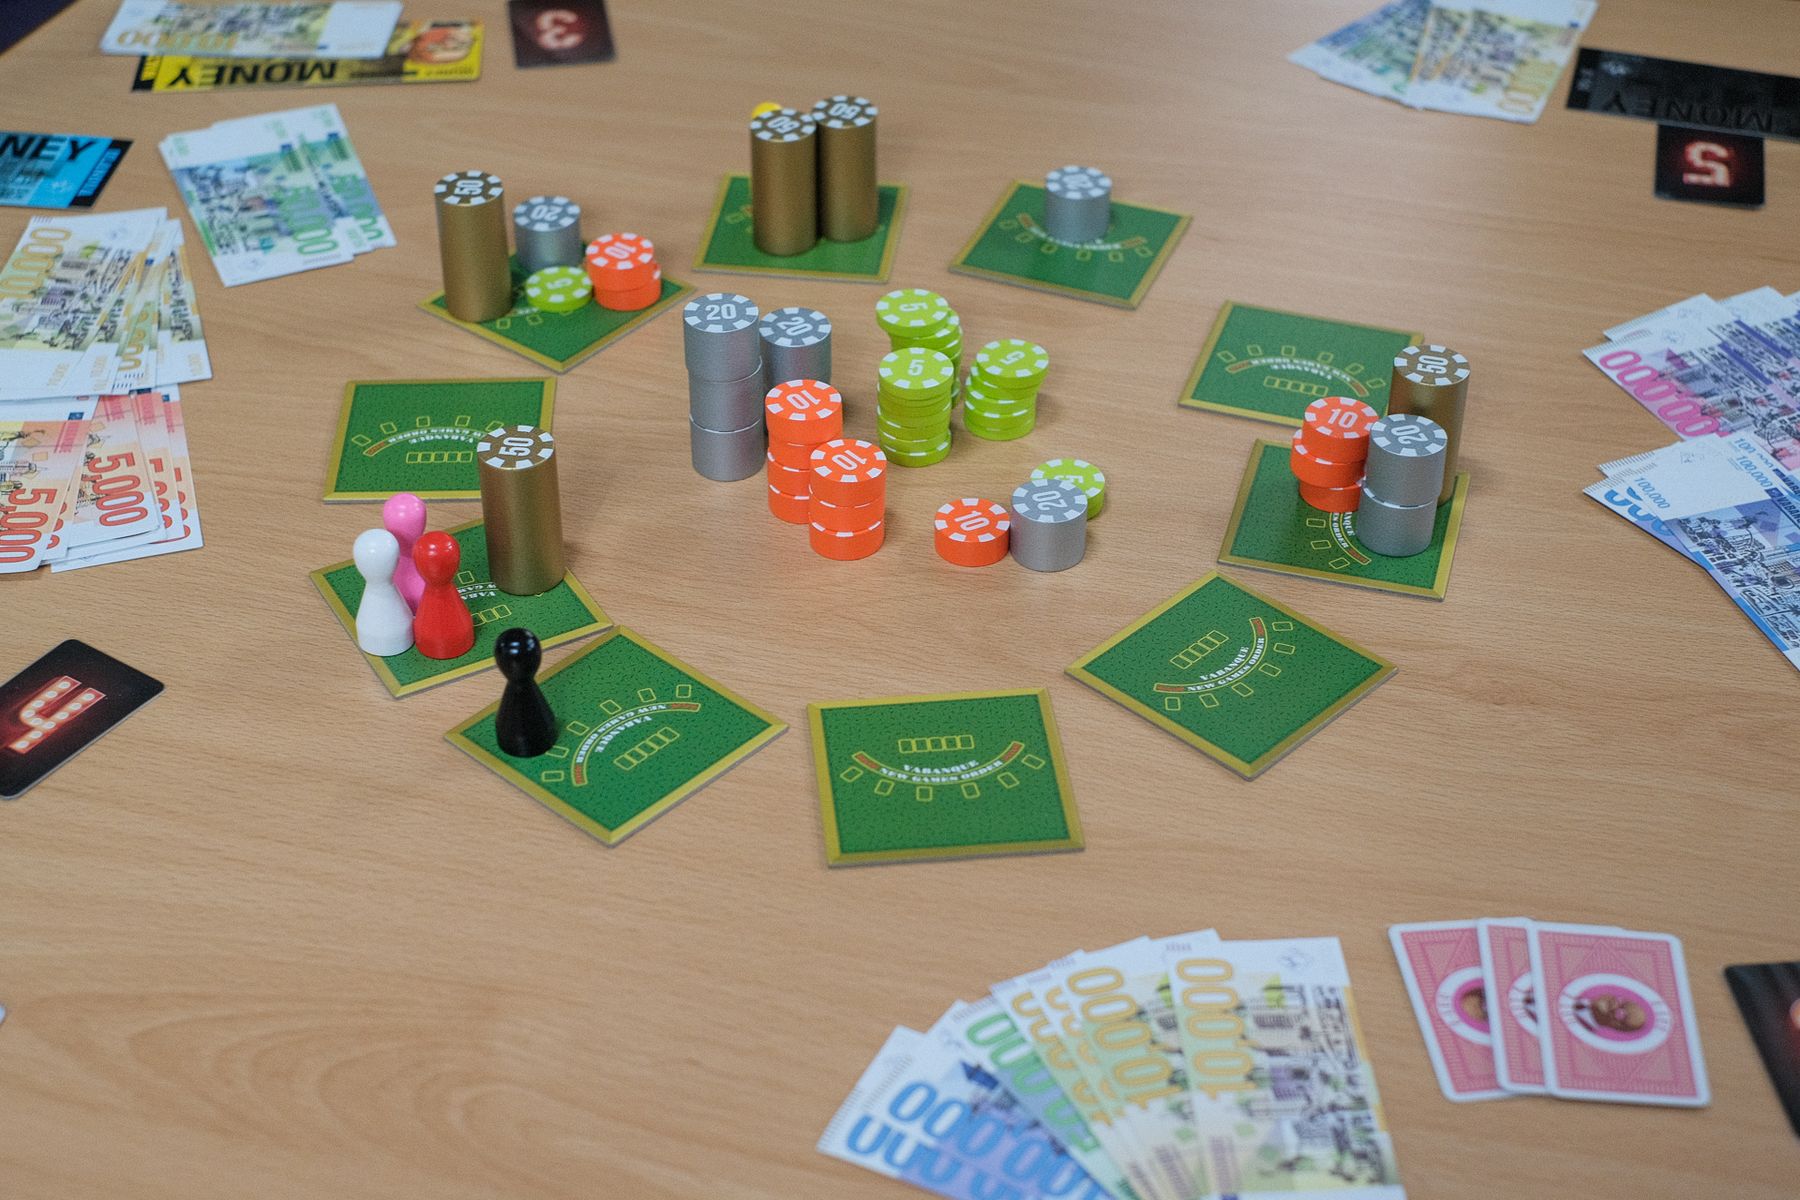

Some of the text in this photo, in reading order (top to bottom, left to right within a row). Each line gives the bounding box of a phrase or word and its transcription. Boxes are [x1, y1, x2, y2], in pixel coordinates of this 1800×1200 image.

[536, 8, 583, 49] 3
[167, 58, 339, 87] MONEY
[829, 102, 862, 119] 50
[767, 116, 800, 133] 50
[1682, 141, 1732, 187] 5
[454, 179, 484, 196] 50
[530, 205, 562, 221] 20
[605, 242, 636, 259] 10
[705, 303, 737, 320] 20
[899, 302, 929, 313] 5
[782, 317, 813, 337] 20
[908, 359, 924, 377] 5
[999, 350, 1026, 365] 5
[1417, 355, 1448, 374] 50
[786, 388, 821, 410] 10
[1327, 408, 1358, 428] 10
[1390, 424, 1429, 446] 20
[499, 437, 534, 456] 50
[831, 448, 867, 471] 10
[1737, 456, 1773, 488] 100,000
[79, 452, 148, 527] 5,000
[1634, 477, 1670, 509] 100,000
[1032, 490, 1067, 511] 20
[954, 510, 990, 532] 10
[1187, 683, 1215, 691] NEW
[1249, 637, 1265, 665] ORDER
[1200, 646, 1249, 680] VABANQUE
[595, 715, 652, 752] VABANQUE
[880, 767, 908, 780] NEW
[961, 760, 1003, 780] ORDER
[904, 760, 979, 774] VABANQUE
[1066, 965, 1187, 1111] 10,000
[1175, 957, 1263, 1101] 10,000
